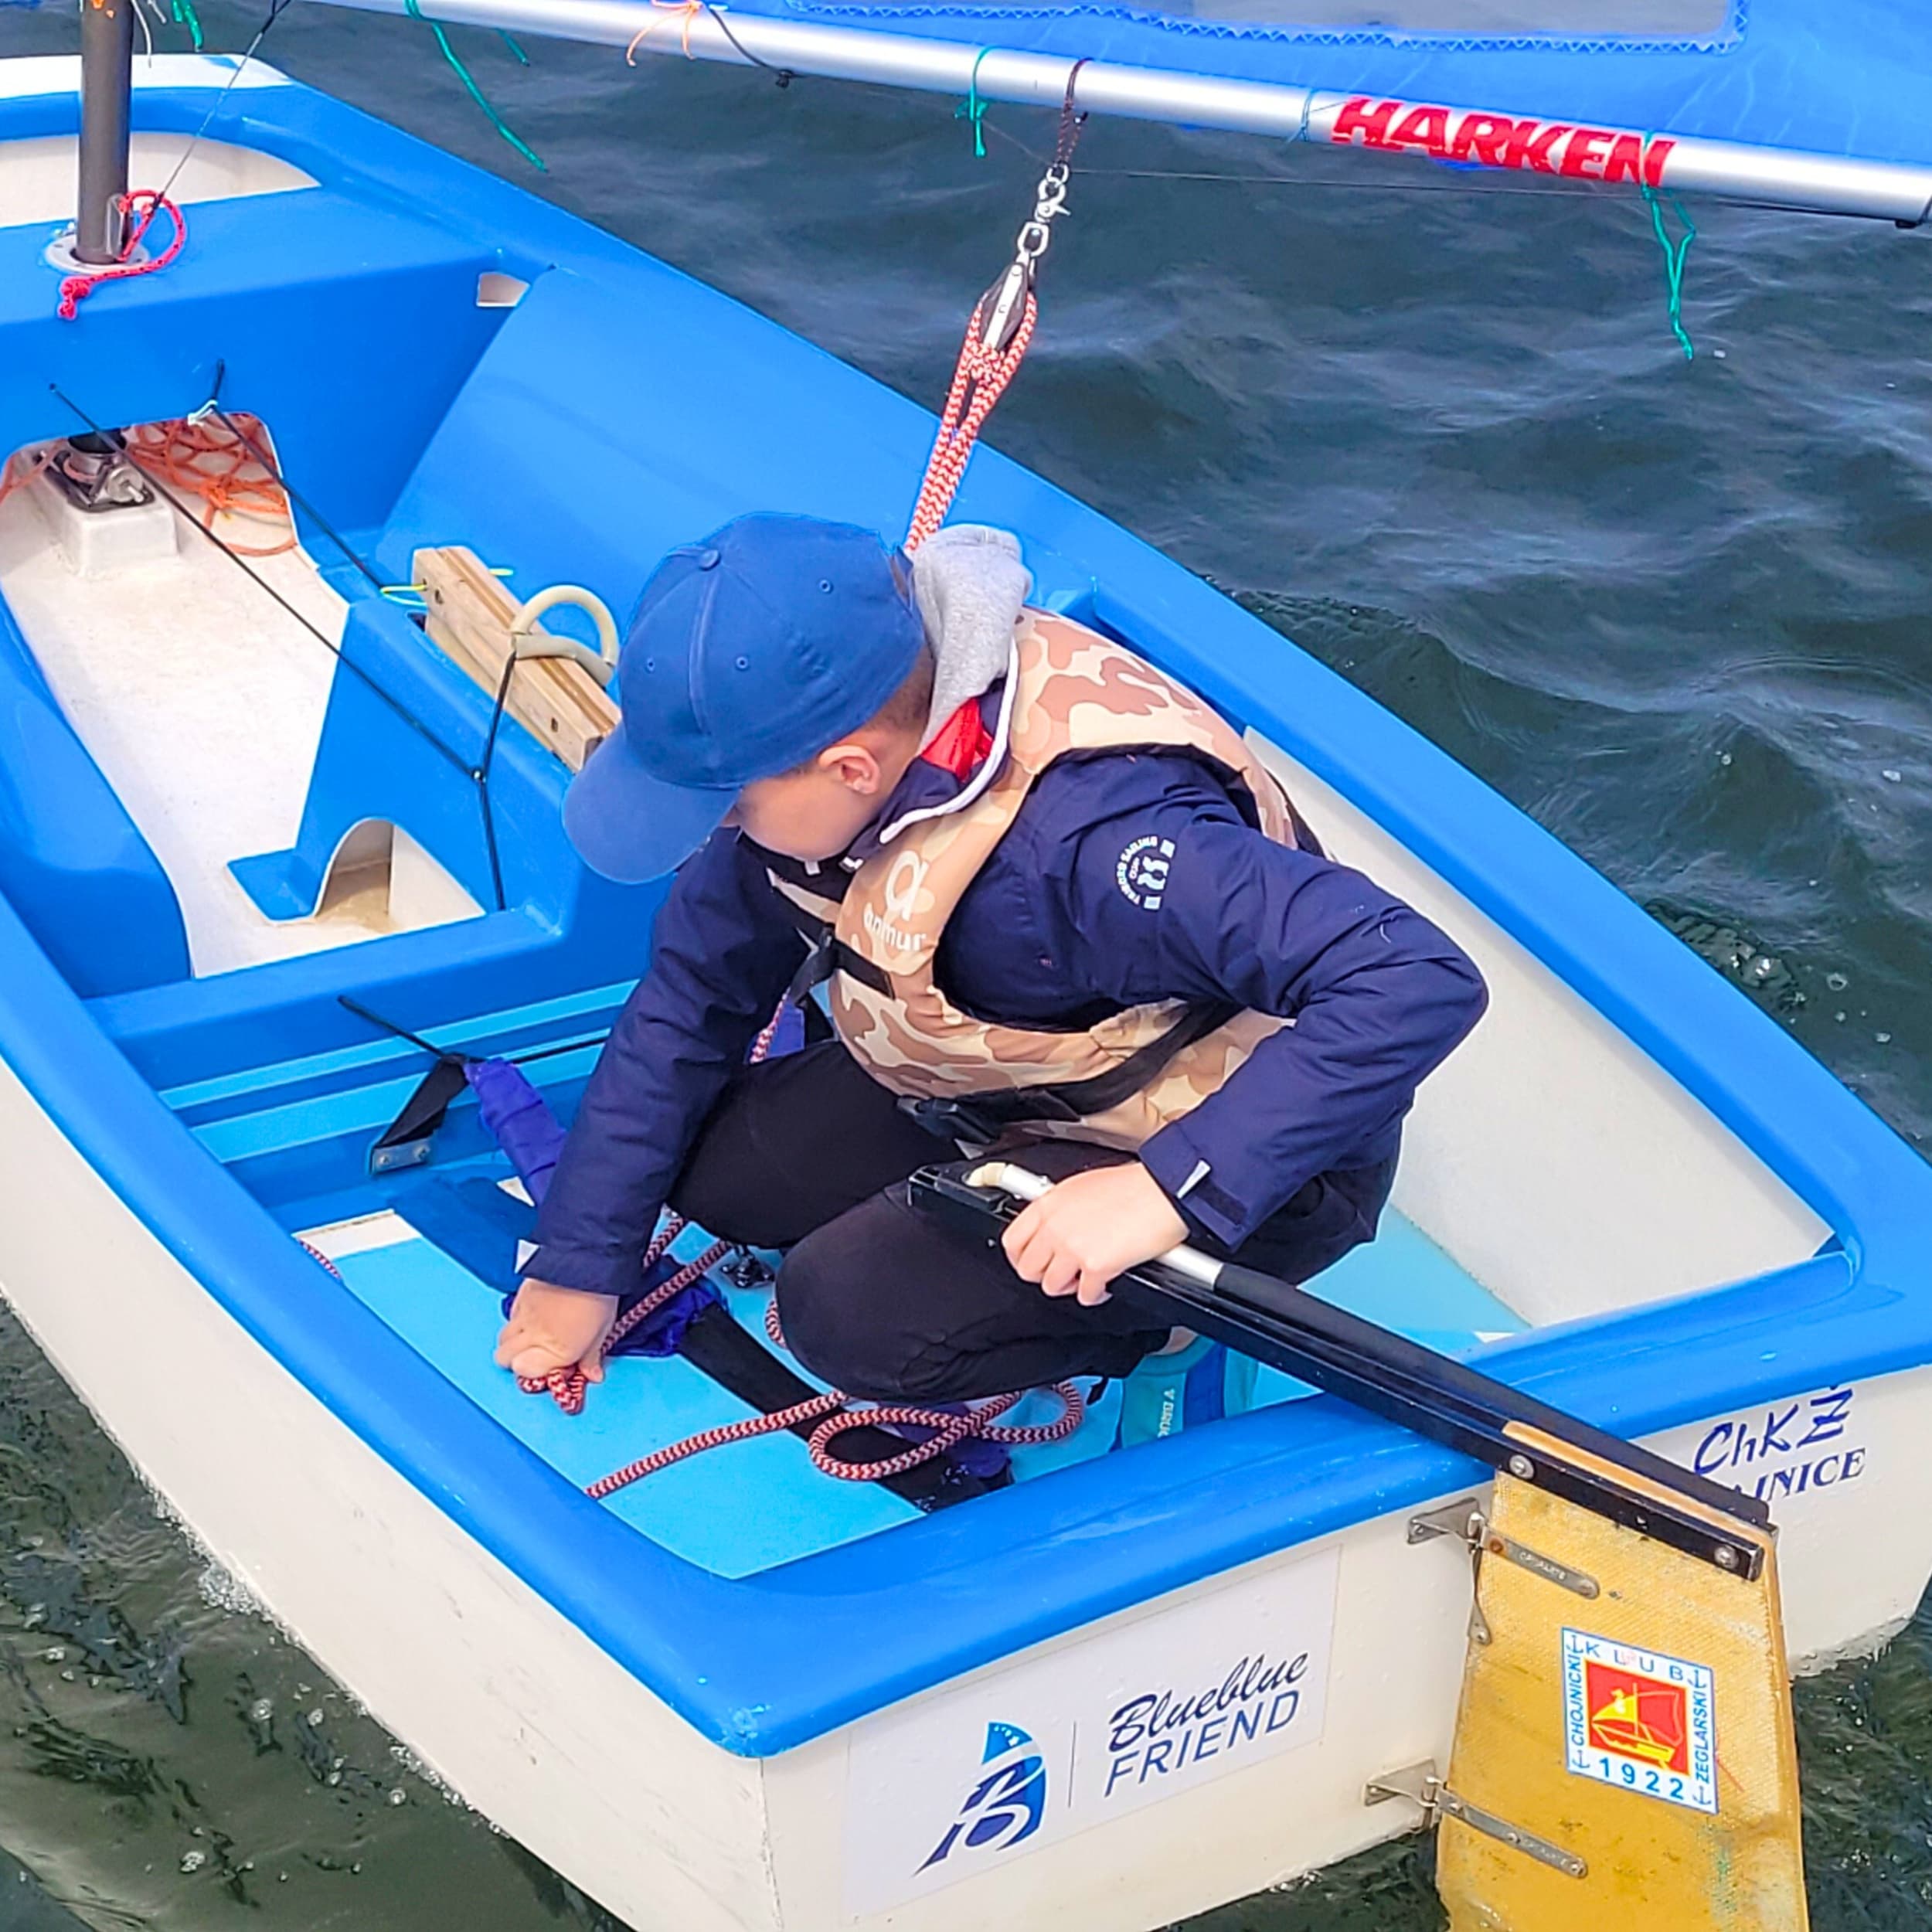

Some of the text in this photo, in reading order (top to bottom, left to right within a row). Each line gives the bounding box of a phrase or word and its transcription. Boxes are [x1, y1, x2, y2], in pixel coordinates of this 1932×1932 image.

[1331, 95, 1676, 186] HARKEN
[1109, 1651, 1309, 1752] Blueblue
[1567, 1654, 1585, 1747] CHOJNICKI
[1585, 1641, 1684, 1681] KLUB
[1104, 1689, 1300, 1798] FRIEND
[1599, 1757, 1685, 1801] 1922
